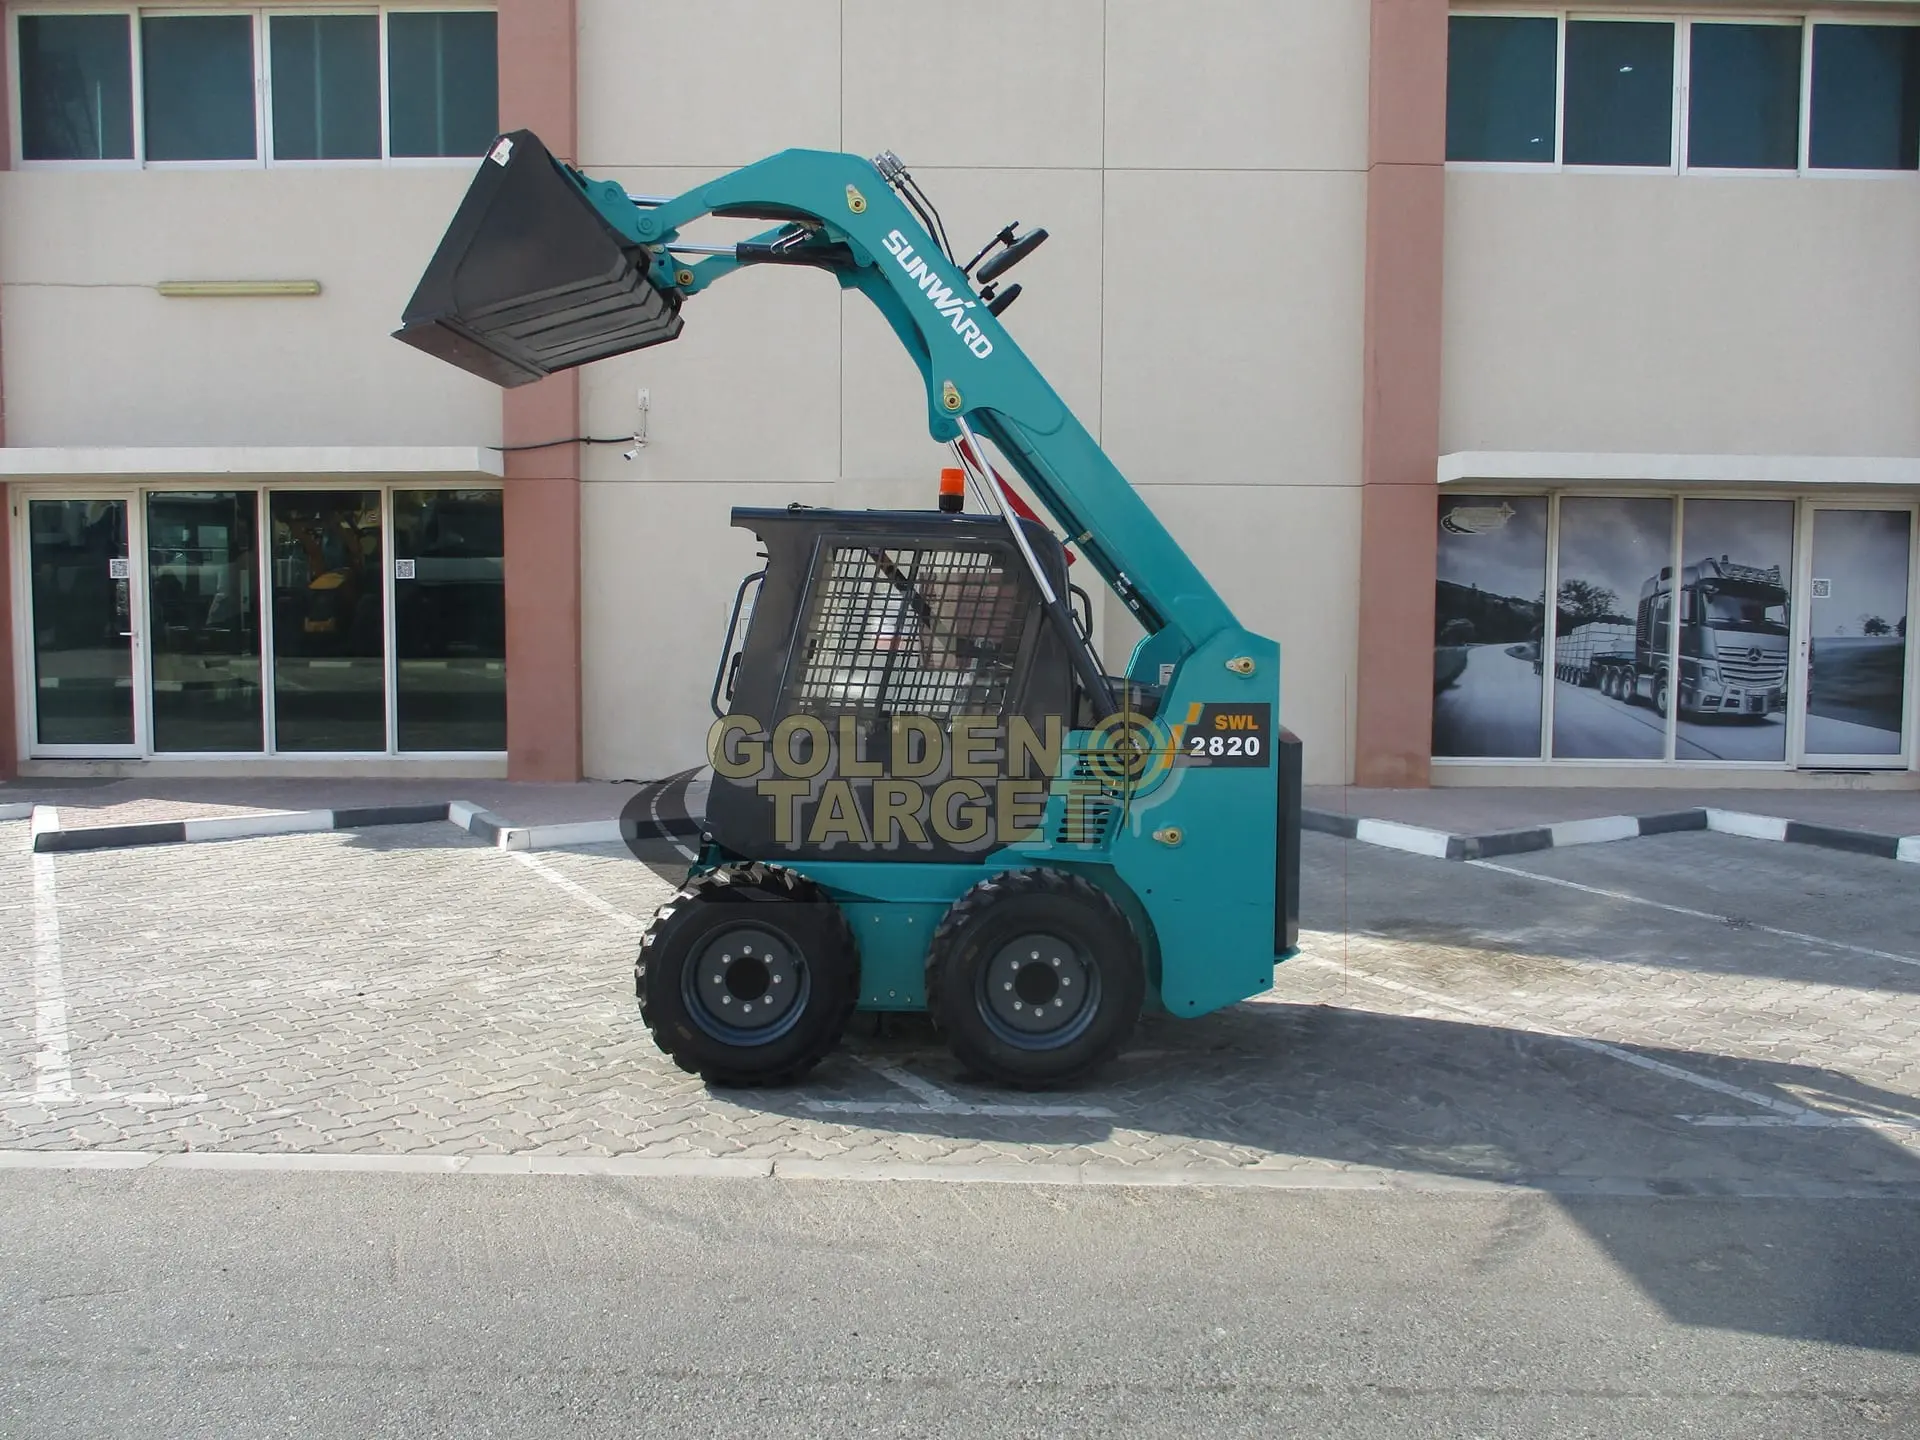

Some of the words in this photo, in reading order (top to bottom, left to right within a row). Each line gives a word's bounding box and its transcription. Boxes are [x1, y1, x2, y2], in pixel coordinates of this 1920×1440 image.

[882, 229, 993, 359] SUNWARD
[1215, 715, 1259, 730] SWL
[1190, 736, 1260, 756] 2820
